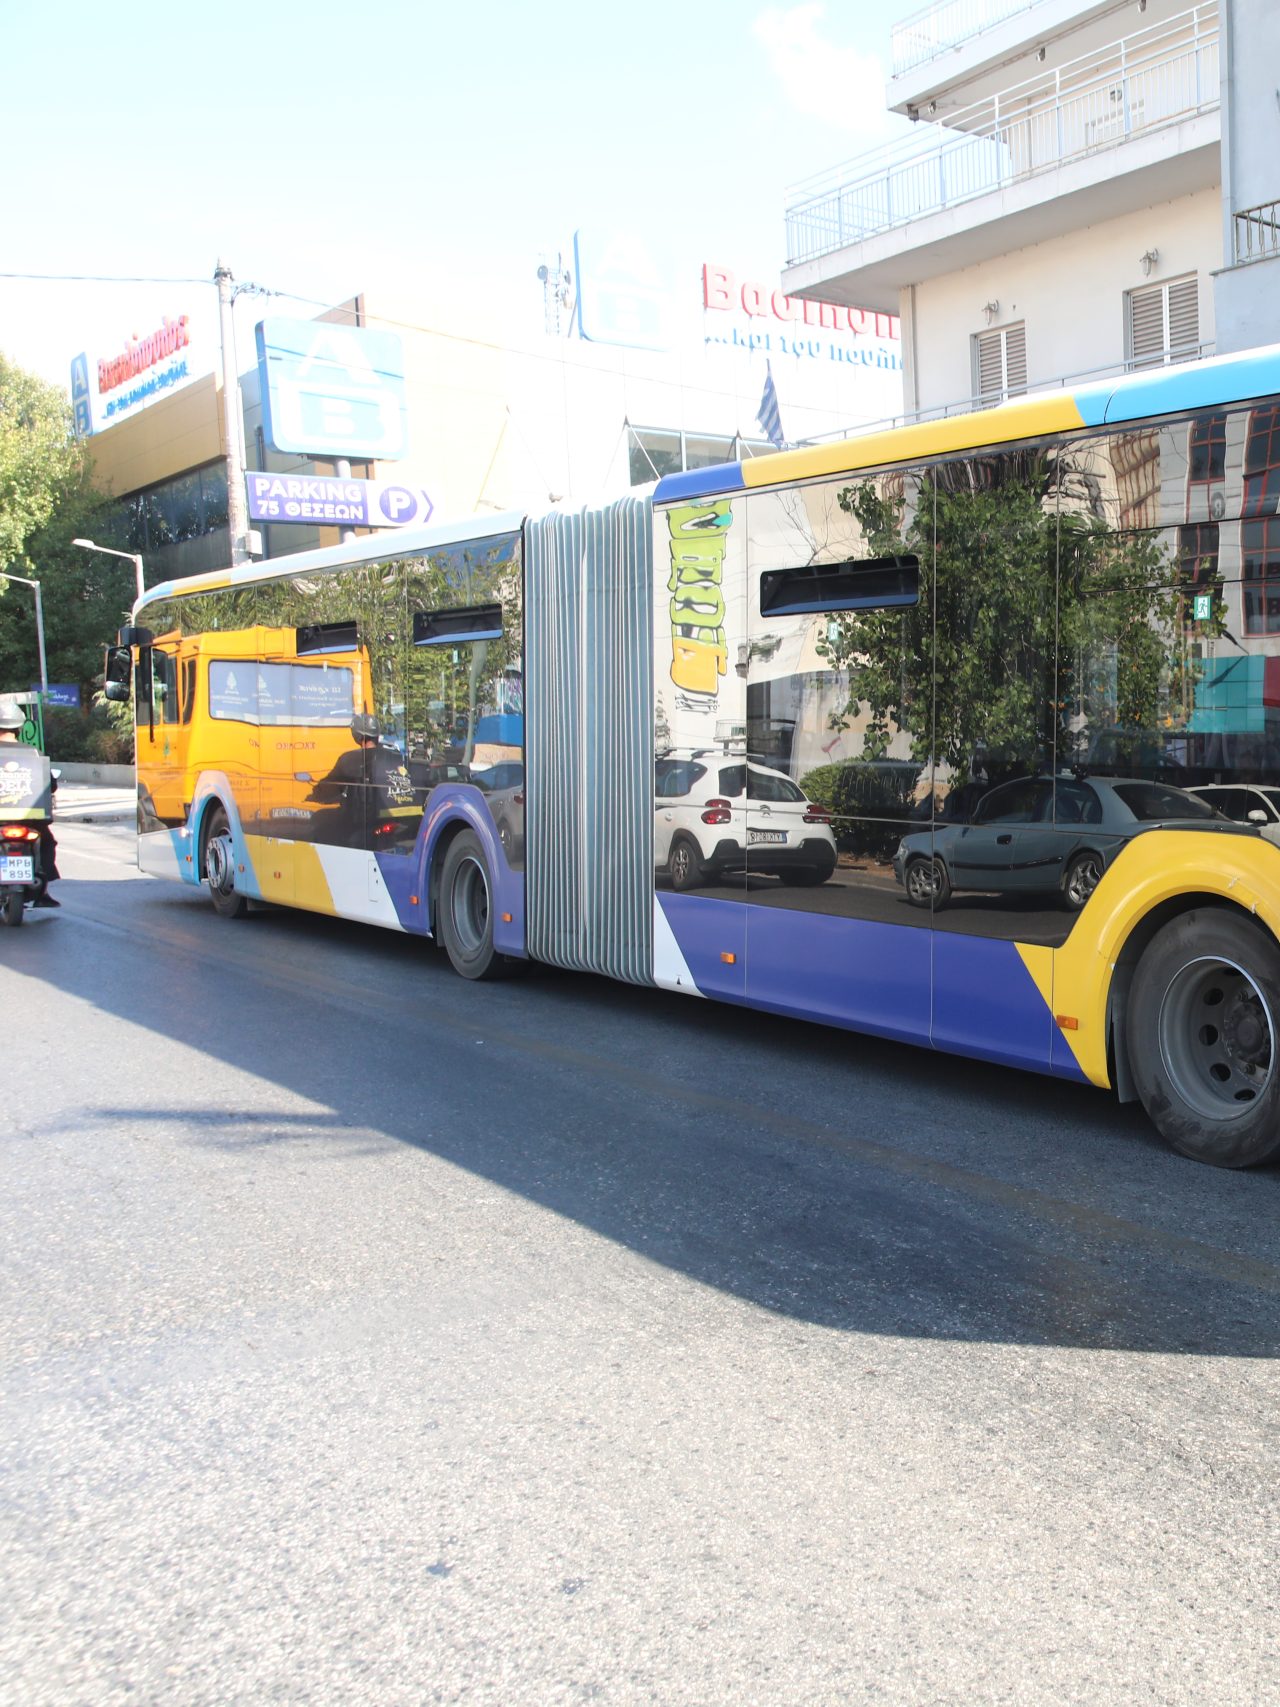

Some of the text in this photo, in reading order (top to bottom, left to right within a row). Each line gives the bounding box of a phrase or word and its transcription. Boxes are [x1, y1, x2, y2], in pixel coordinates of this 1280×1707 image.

[255, 477, 362, 503] PARKING
[257, 500, 364, 520] 75 ΘΕΣΕΩΝ
[388, 490, 410, 519] P
[9, 869, 32, 879] 895
